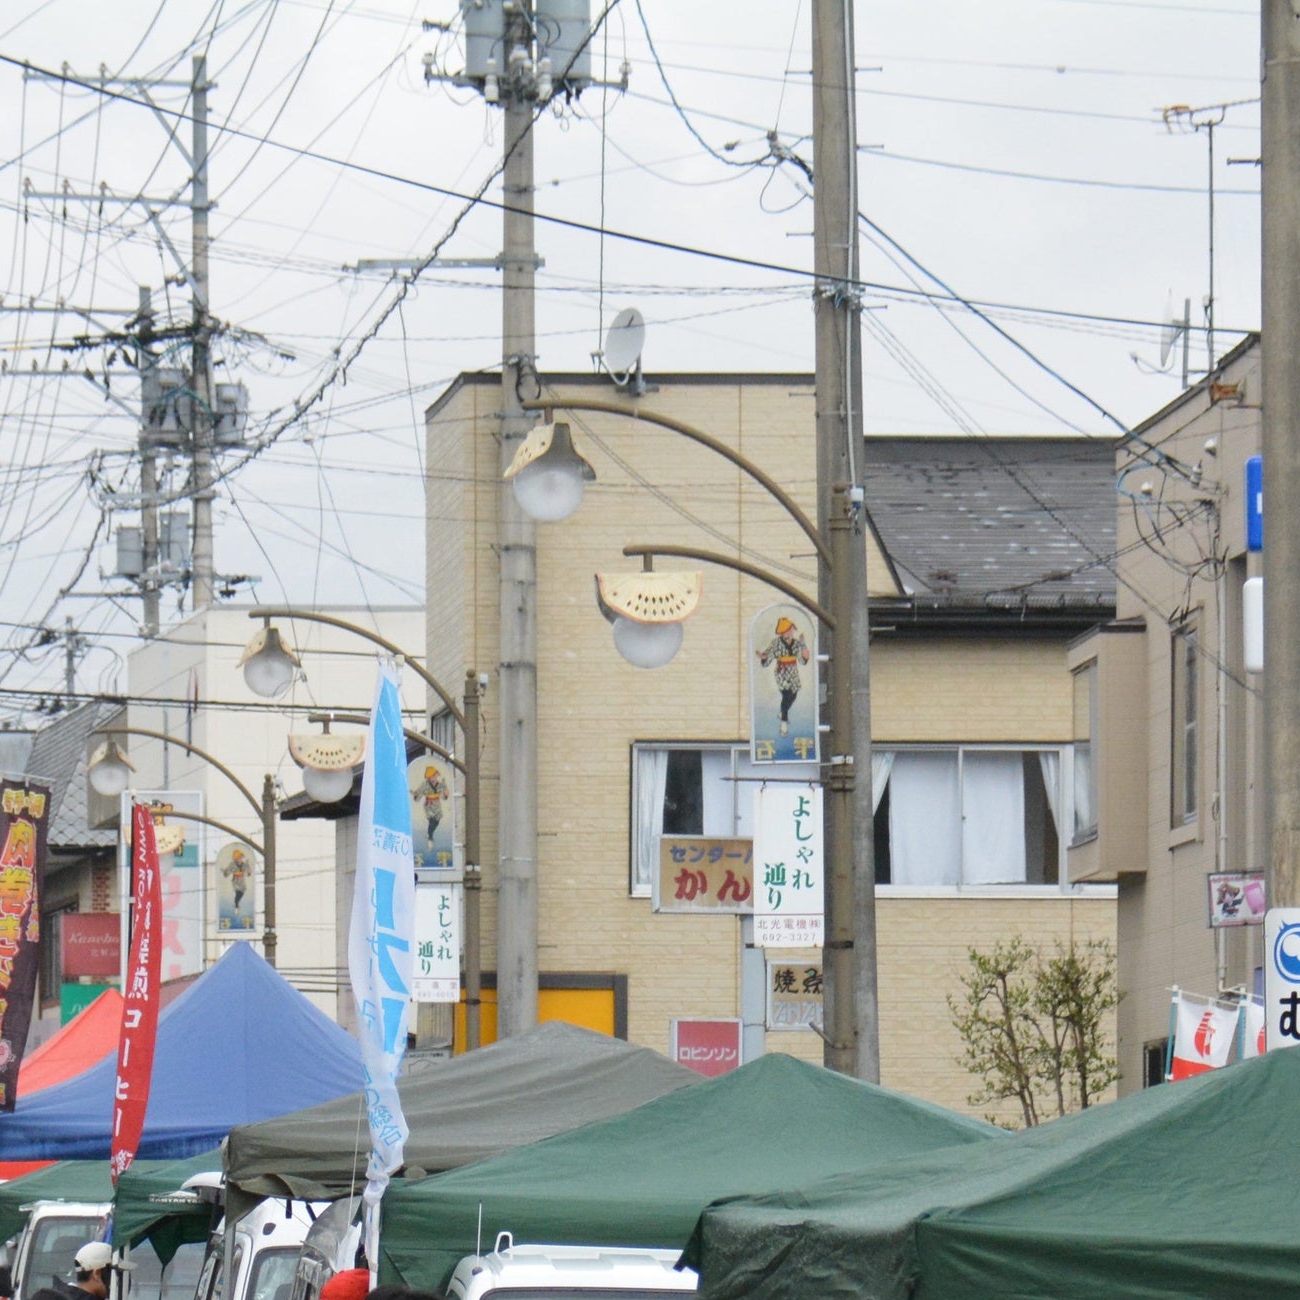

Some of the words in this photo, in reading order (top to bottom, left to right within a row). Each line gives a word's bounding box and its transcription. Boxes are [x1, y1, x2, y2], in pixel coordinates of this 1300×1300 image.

[791, 794, 815, 890] よしゃれ
[763, 862, 787, 912] 通り
[437, 893, 454, 960] よしゃれ
[417, 940, 434, 976] 通り
[679, 1047, 737, 1061] ロビンソン
